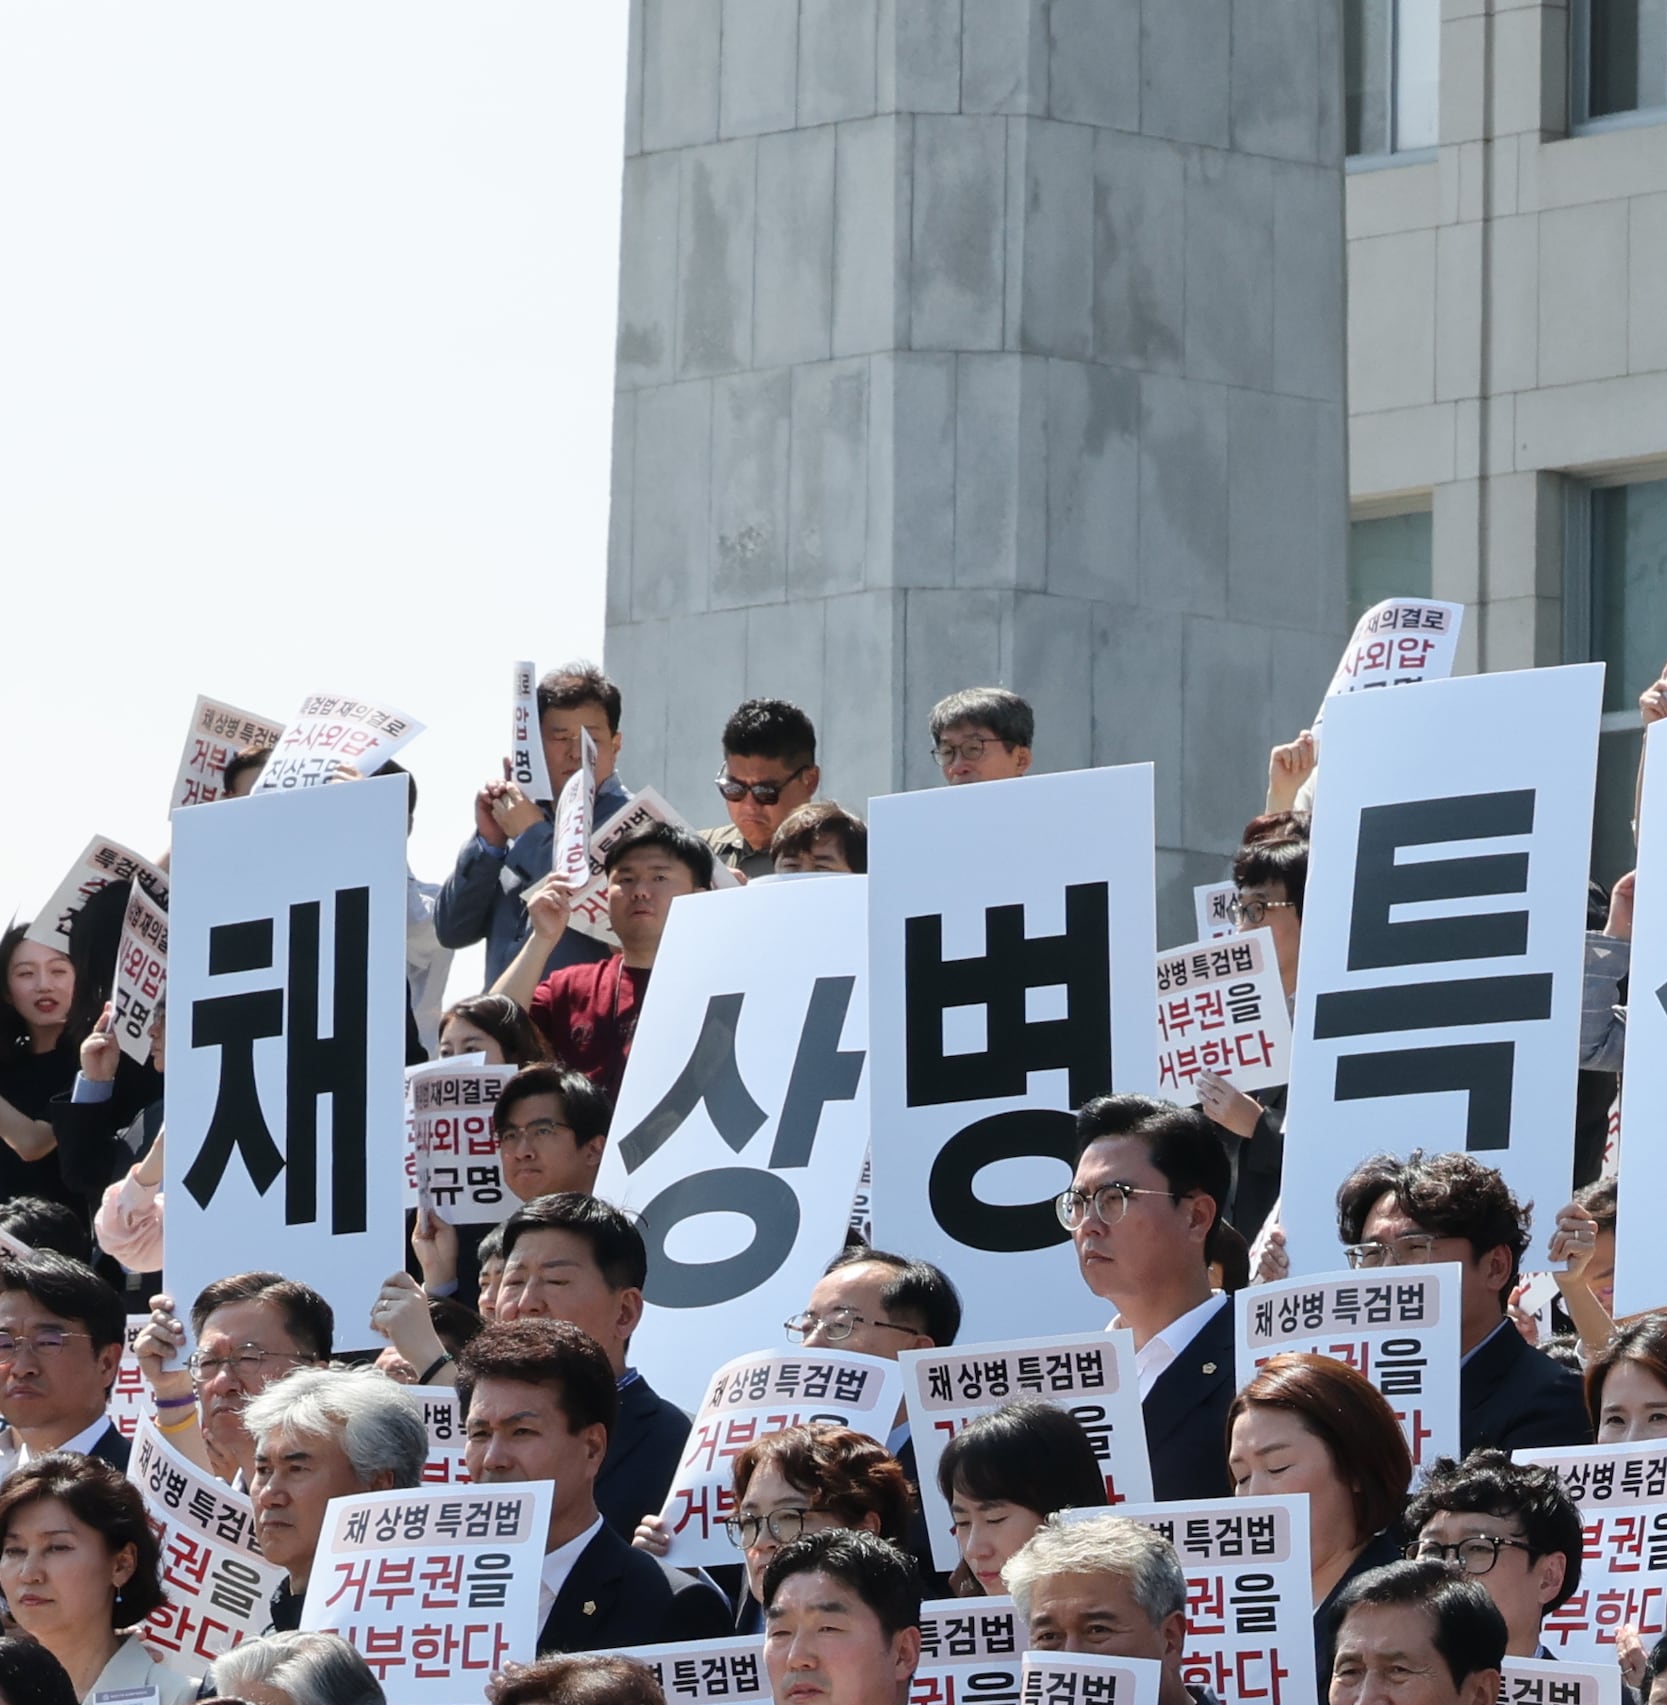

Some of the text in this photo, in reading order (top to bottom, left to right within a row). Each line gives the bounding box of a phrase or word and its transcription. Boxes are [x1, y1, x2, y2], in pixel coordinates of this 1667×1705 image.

[1365, 609, 1445, 634] 재의결로
[214, 714, 240, 739] 상병
[284, 723, 380, 757] 수사외압
[337, 700, 407, 738] 재의결로
[1157, 944, 1253, 991] 상병 특검법
[1313, 788, 1554, 1151] 특
[182, 886, 370, 1235] 채
[905, 881, 1113, 1253] 병
[430, 1078, 501, 1107] 재의결로
[617, 975, 868, 1308] 상
[1254, 1281, 1425, 1337] 채 상병 특검법
[729, 1363, 869, 1403] 상병 특검법
[927, 1349, 1105, 1400] 채 상병 특검법
[149, 1453, 186, 1510] 상병
[1565, 1461, 1613, 1500] 상병
[343, 1499, 524, 1545] 채 상병 특검법
[1182, 1514, 1276, 1556] 특검법
[331, 1552, 515, 1611] 거부권을
[920, 1616, 1016, 1657] 특검법
[672, 1653, 760, 1698] 특검법
